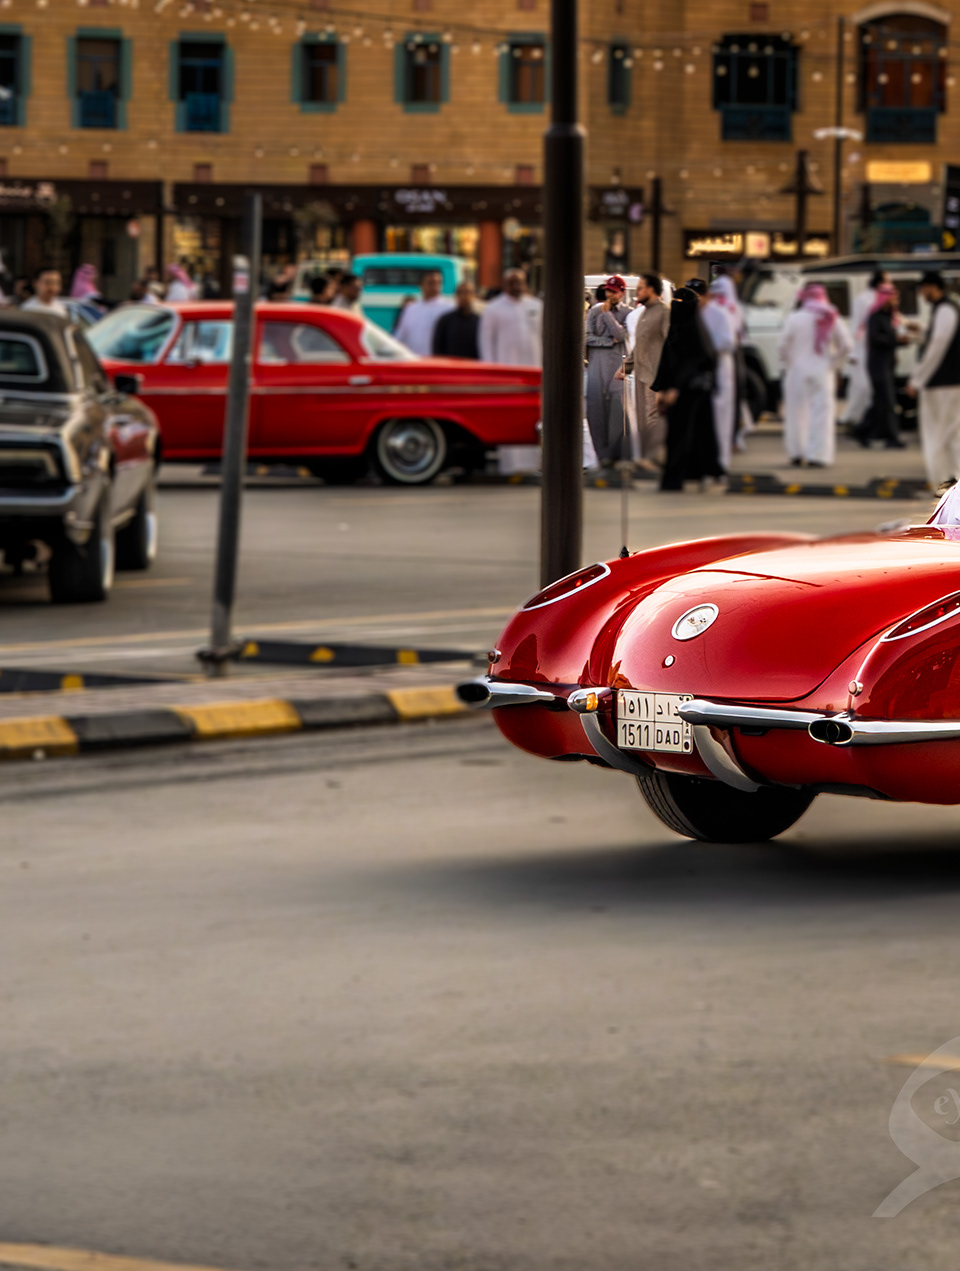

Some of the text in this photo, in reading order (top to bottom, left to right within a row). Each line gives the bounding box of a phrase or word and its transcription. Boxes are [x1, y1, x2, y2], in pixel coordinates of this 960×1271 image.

[622, 696, 649, 718] ١٥١١
[621, 723, 680, 747] 1511 DAD
